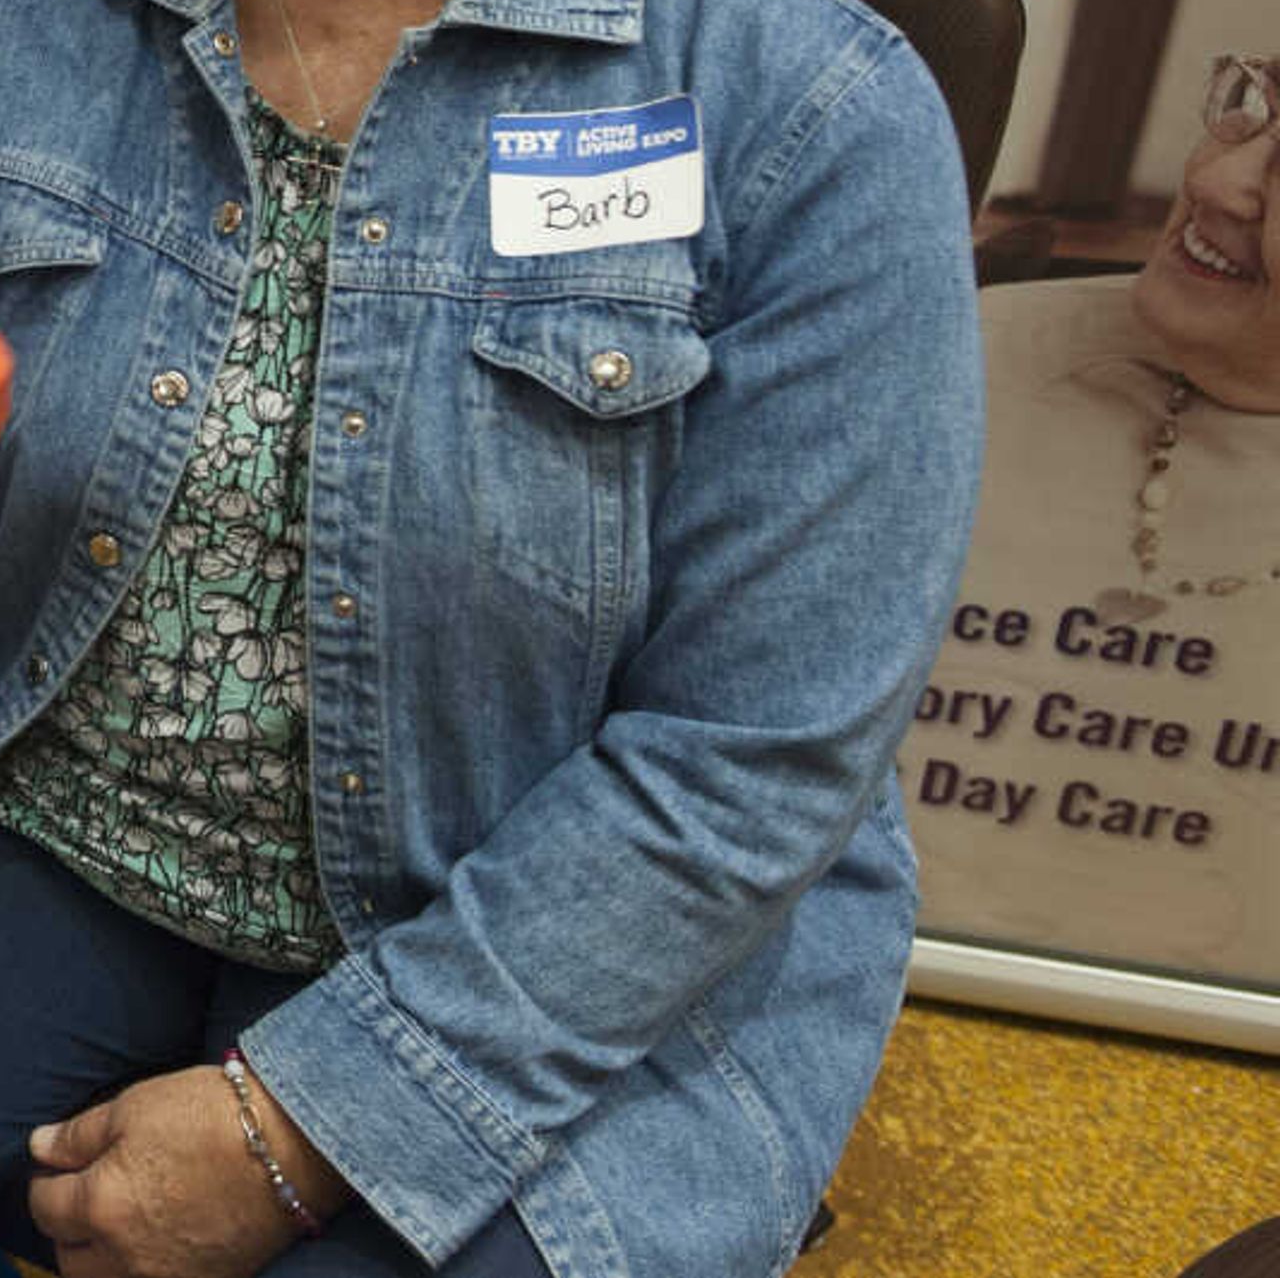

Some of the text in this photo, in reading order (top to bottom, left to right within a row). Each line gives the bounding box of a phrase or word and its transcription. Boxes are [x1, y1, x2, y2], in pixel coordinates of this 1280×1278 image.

[493, 130, 560, 154] TBY
[538, 176, 650, 230] Barb
[1054, 607, 1216, 676] Care
[1032, 692, 1191, 759] Care
[918, 758, 1213, 847] Day Care
